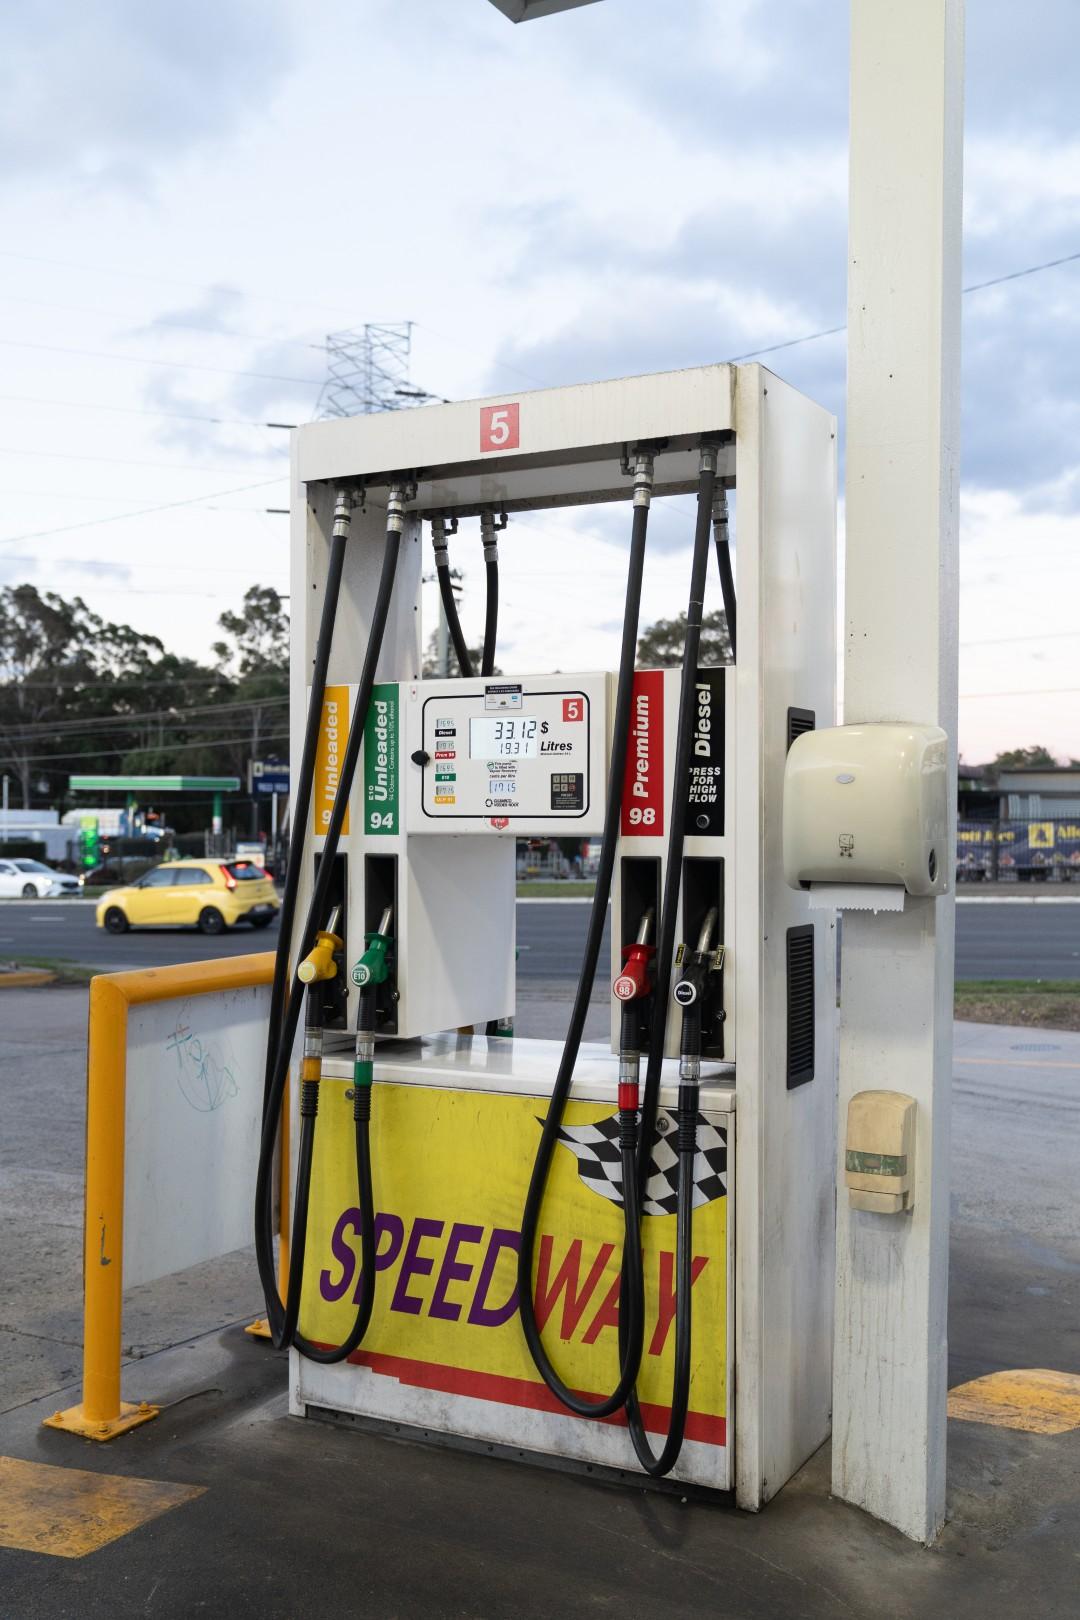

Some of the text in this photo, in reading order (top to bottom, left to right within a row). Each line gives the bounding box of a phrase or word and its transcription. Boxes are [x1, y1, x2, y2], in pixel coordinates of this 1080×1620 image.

[489, 410, 510, 445] 5
[567, 701, 579, 719] 5
[540, 721, 550, 735] $
[694, 683, 712, 758] Diesel
[494, 721, 537, 740] 33.12
[324, 700, 338, 800] Unleaded
[374, 700, 388, 802] Unleaded
[500, 742, 529, 755] 19.31
[540, 741, 573, 752] Litres
[633, 695, 650, 798] Premium
[692, 776, 714, 785] FOR
[689, 785, 717, 794] HIGH
[689, 794, 718, 803] FLOW
[321, 809, 332, 825] 9
[370, 812, 394, 829] 94
[629, 807, 656, 825] 98
[618, 986, 630, 996] 98
